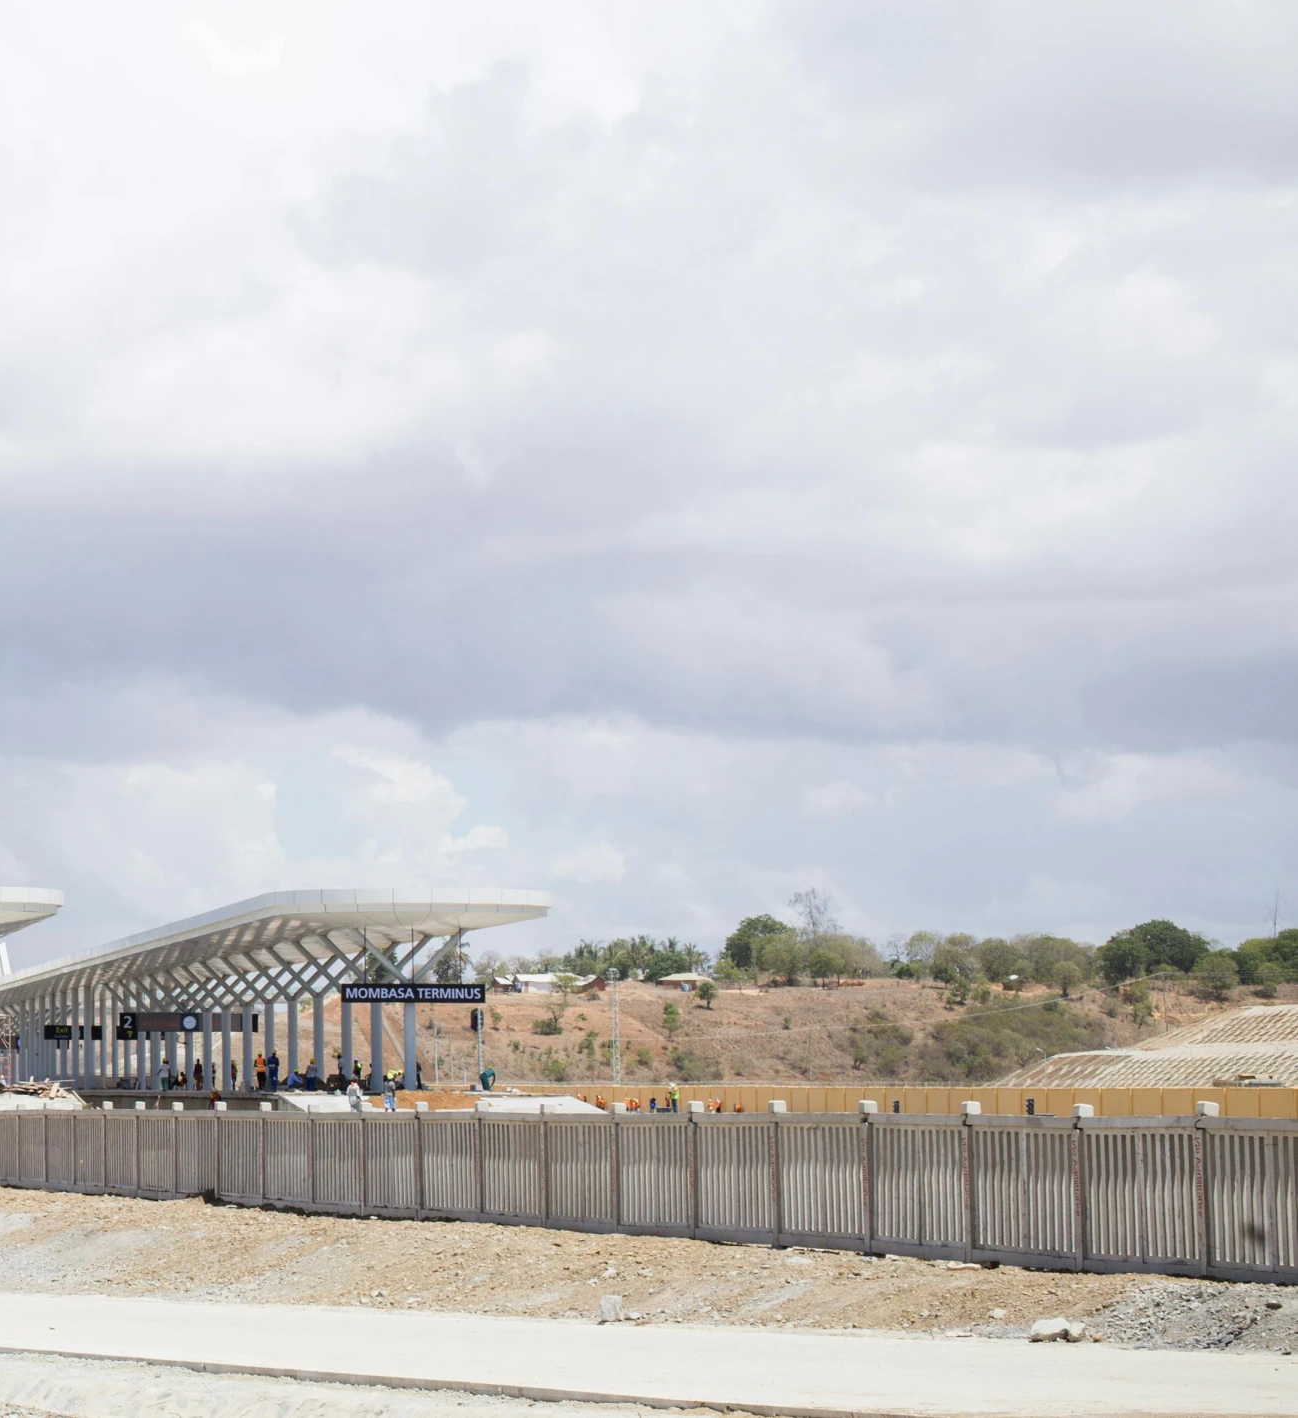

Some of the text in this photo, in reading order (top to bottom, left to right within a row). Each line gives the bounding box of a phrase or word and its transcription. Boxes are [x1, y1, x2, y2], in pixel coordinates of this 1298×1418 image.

[345, 987, 482, 1000] MOMBASA TERMINUS
[123, 1015, 133, 1029] 2
[55, 1026, 69, 1034] Exit
